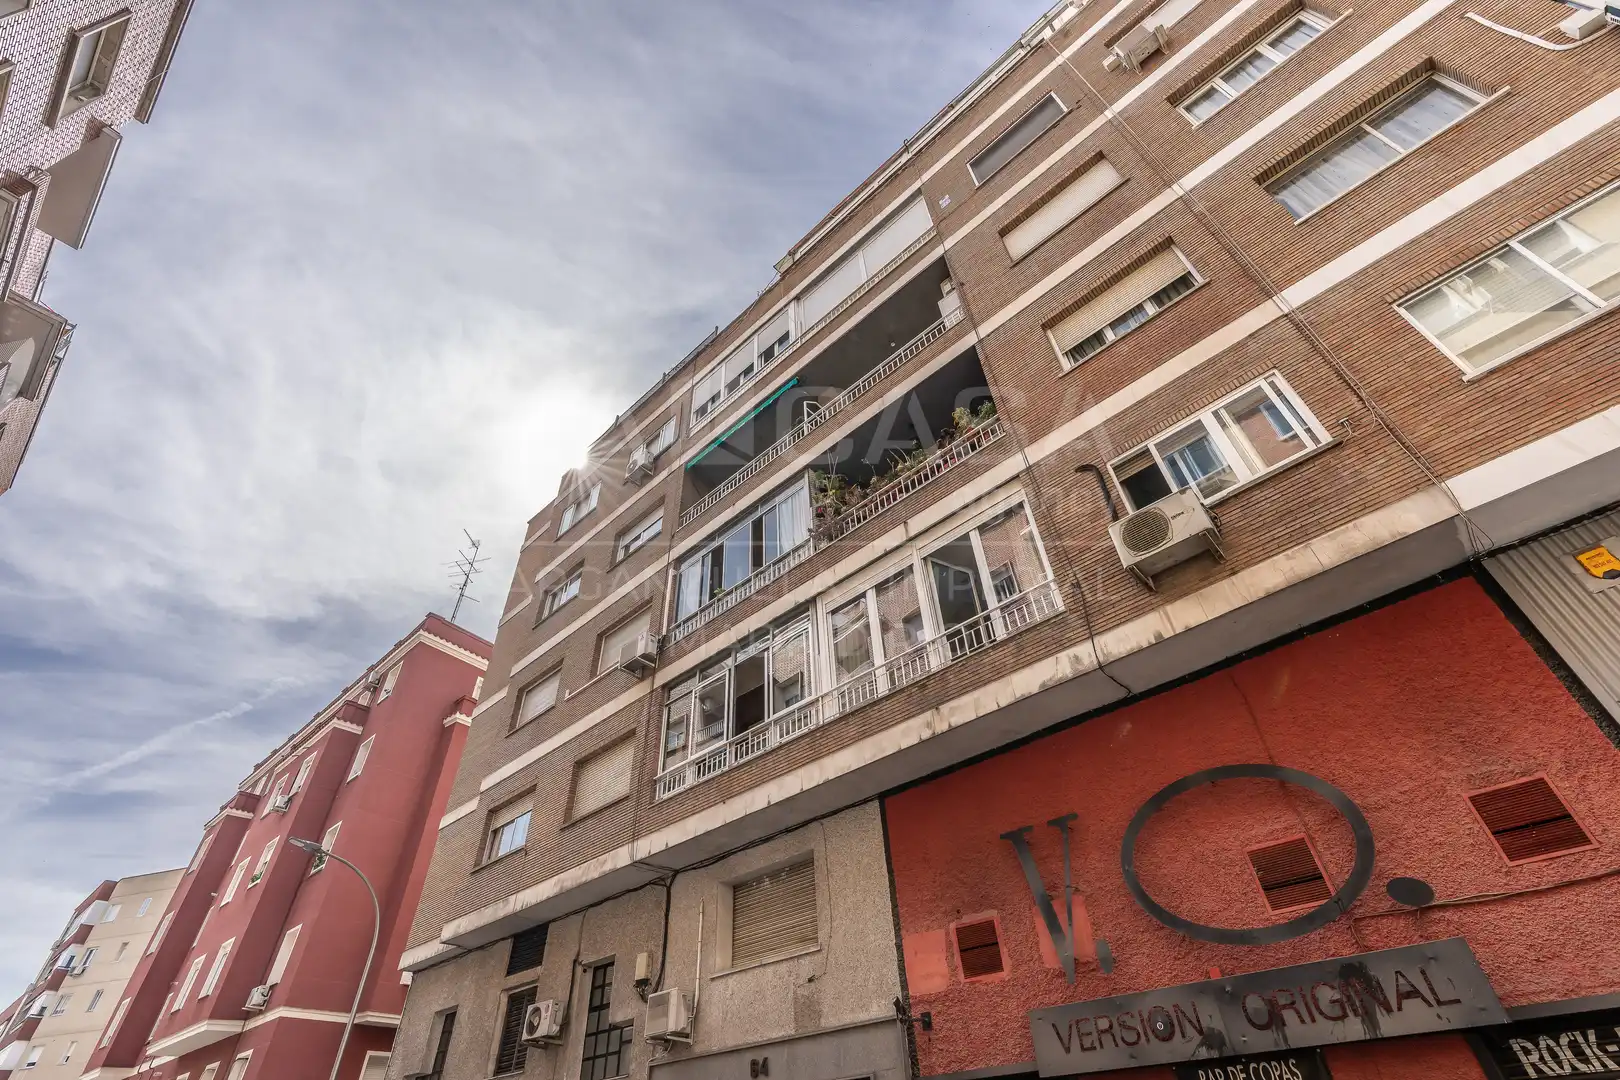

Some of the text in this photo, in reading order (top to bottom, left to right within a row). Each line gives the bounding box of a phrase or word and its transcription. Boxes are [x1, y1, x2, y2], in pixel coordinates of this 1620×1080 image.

[1051, 966, 1462, 1055] VERSION ORIGINAL
[1249, 1058, 1302, 1080] COPAS
